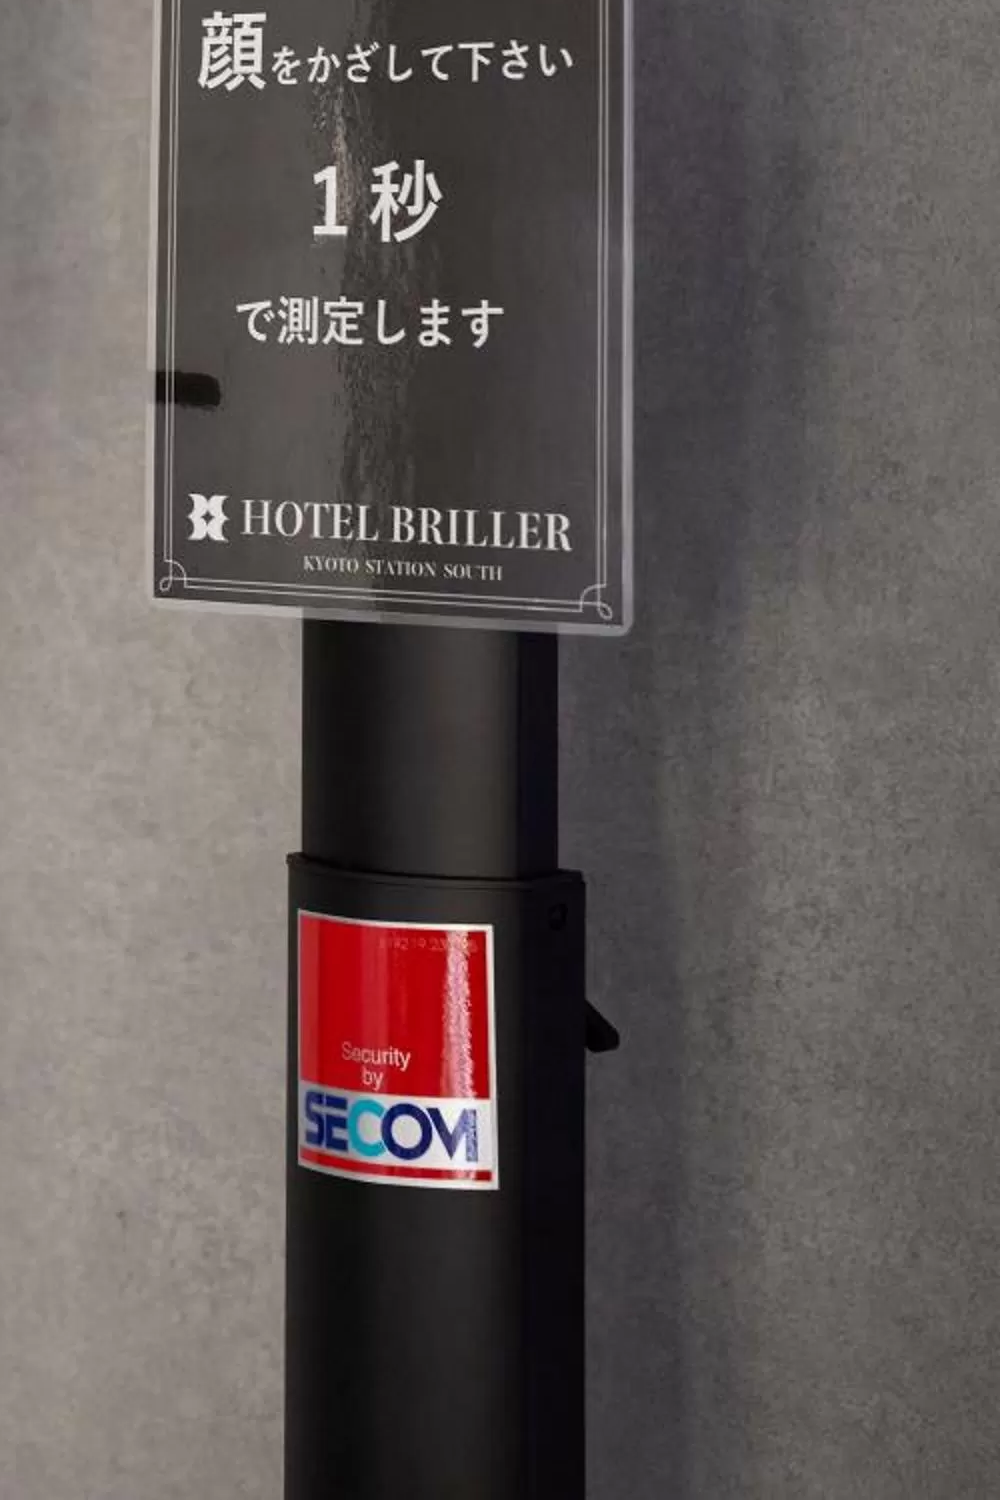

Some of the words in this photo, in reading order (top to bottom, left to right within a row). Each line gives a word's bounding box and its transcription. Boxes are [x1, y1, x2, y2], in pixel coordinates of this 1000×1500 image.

[199, 11, 574, 91] 顔をかざして下さい
[236, 296, 505, 349] で測定します
[240, 499, 380, 543] HOTEL
[391, 506, 574, 552] BRILLER
[303, 555, 360, 575] KYOTO
[365, 559, 437, 578] STATION
[443, 564, 503, 582] SOUTH
[342, 1041, 411, 1073] Security
[362, 1066, 384, 1091] by
[305, 1090, 479, 1164] SECOM
